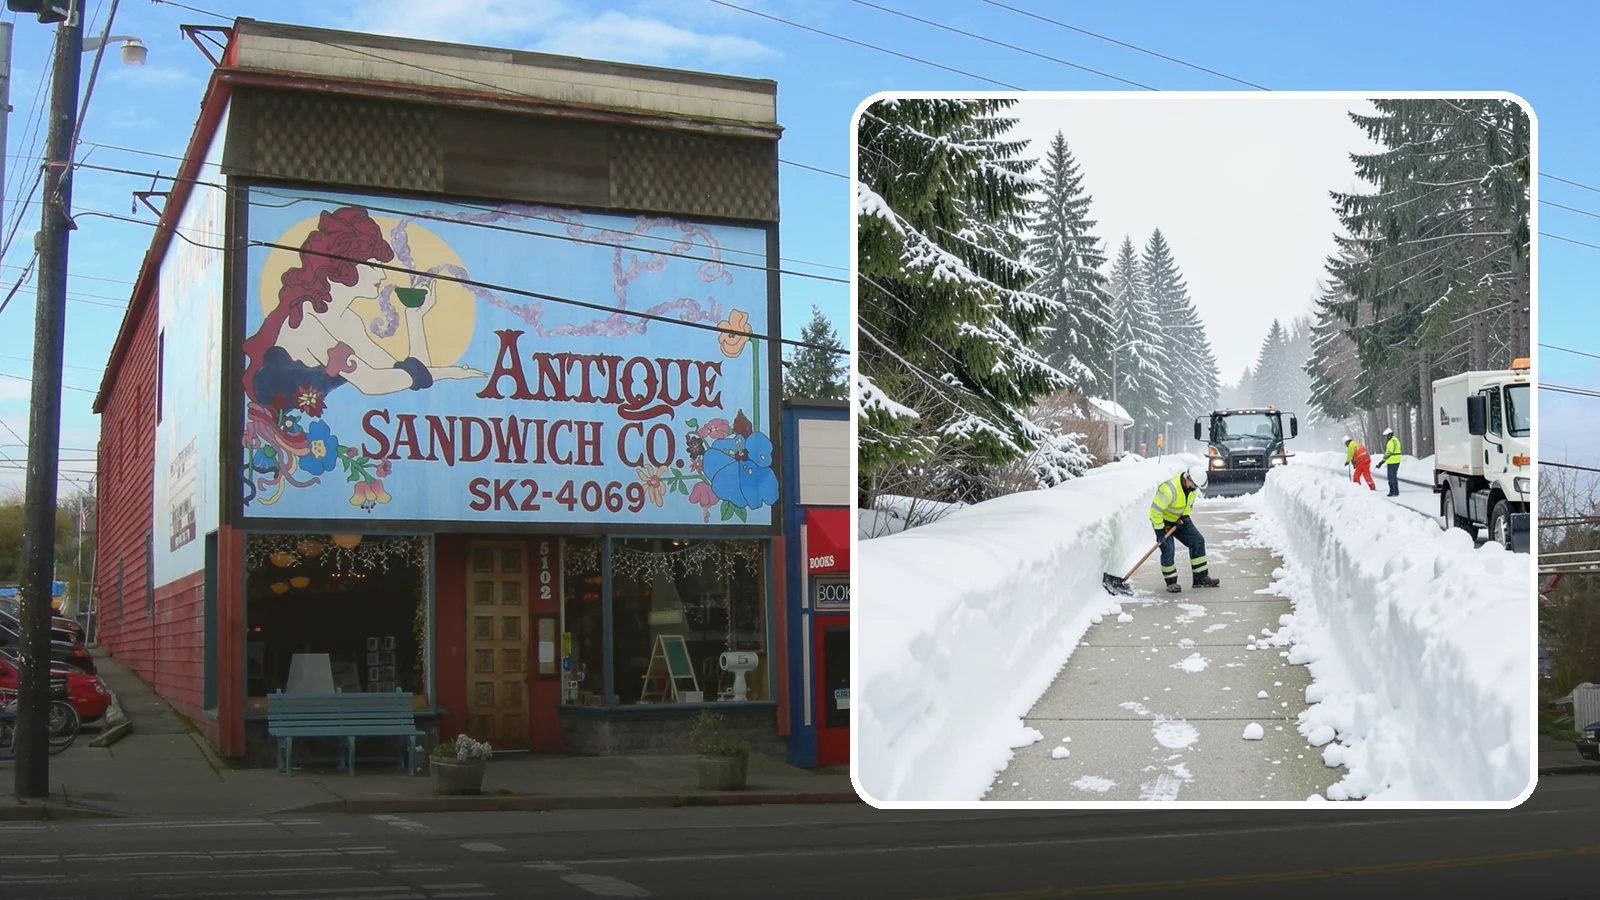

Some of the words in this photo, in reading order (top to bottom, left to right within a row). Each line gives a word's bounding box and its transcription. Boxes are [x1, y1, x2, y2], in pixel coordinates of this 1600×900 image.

[476, 329, 724, 421] ANTIQUE
[361, 408, 605, 468] SANDWICH
[617, 421, 685, 469] CO.
[468, 476, 646, 513] SK2-4069
[539, 542, 551, 599] 5102
[809, 555, 834, 569] BOOKS
